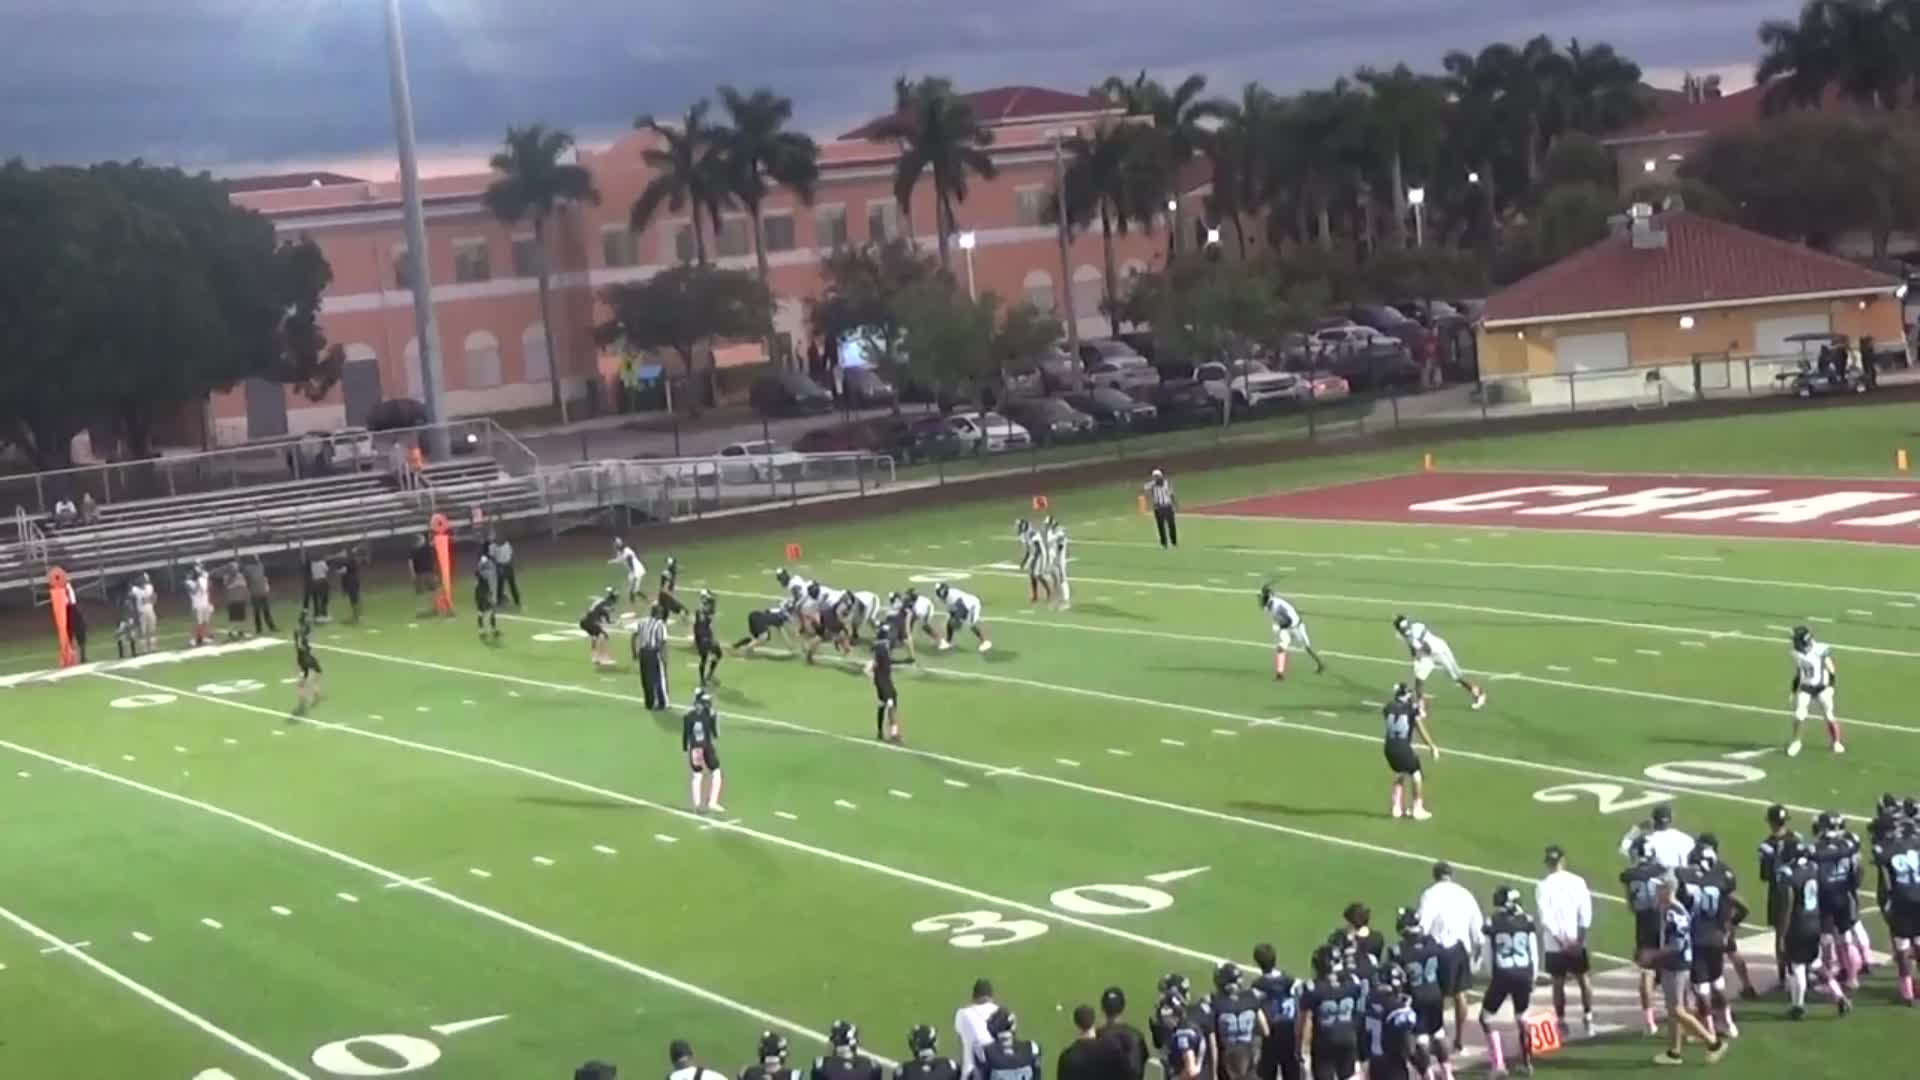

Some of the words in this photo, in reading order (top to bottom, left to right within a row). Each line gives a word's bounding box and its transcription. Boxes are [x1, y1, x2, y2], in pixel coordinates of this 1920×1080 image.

[1533, 760, 1766, 813] 20
[912, 884, 1174, 948] 30
[1528, 1019, 1557, 1050] 30
